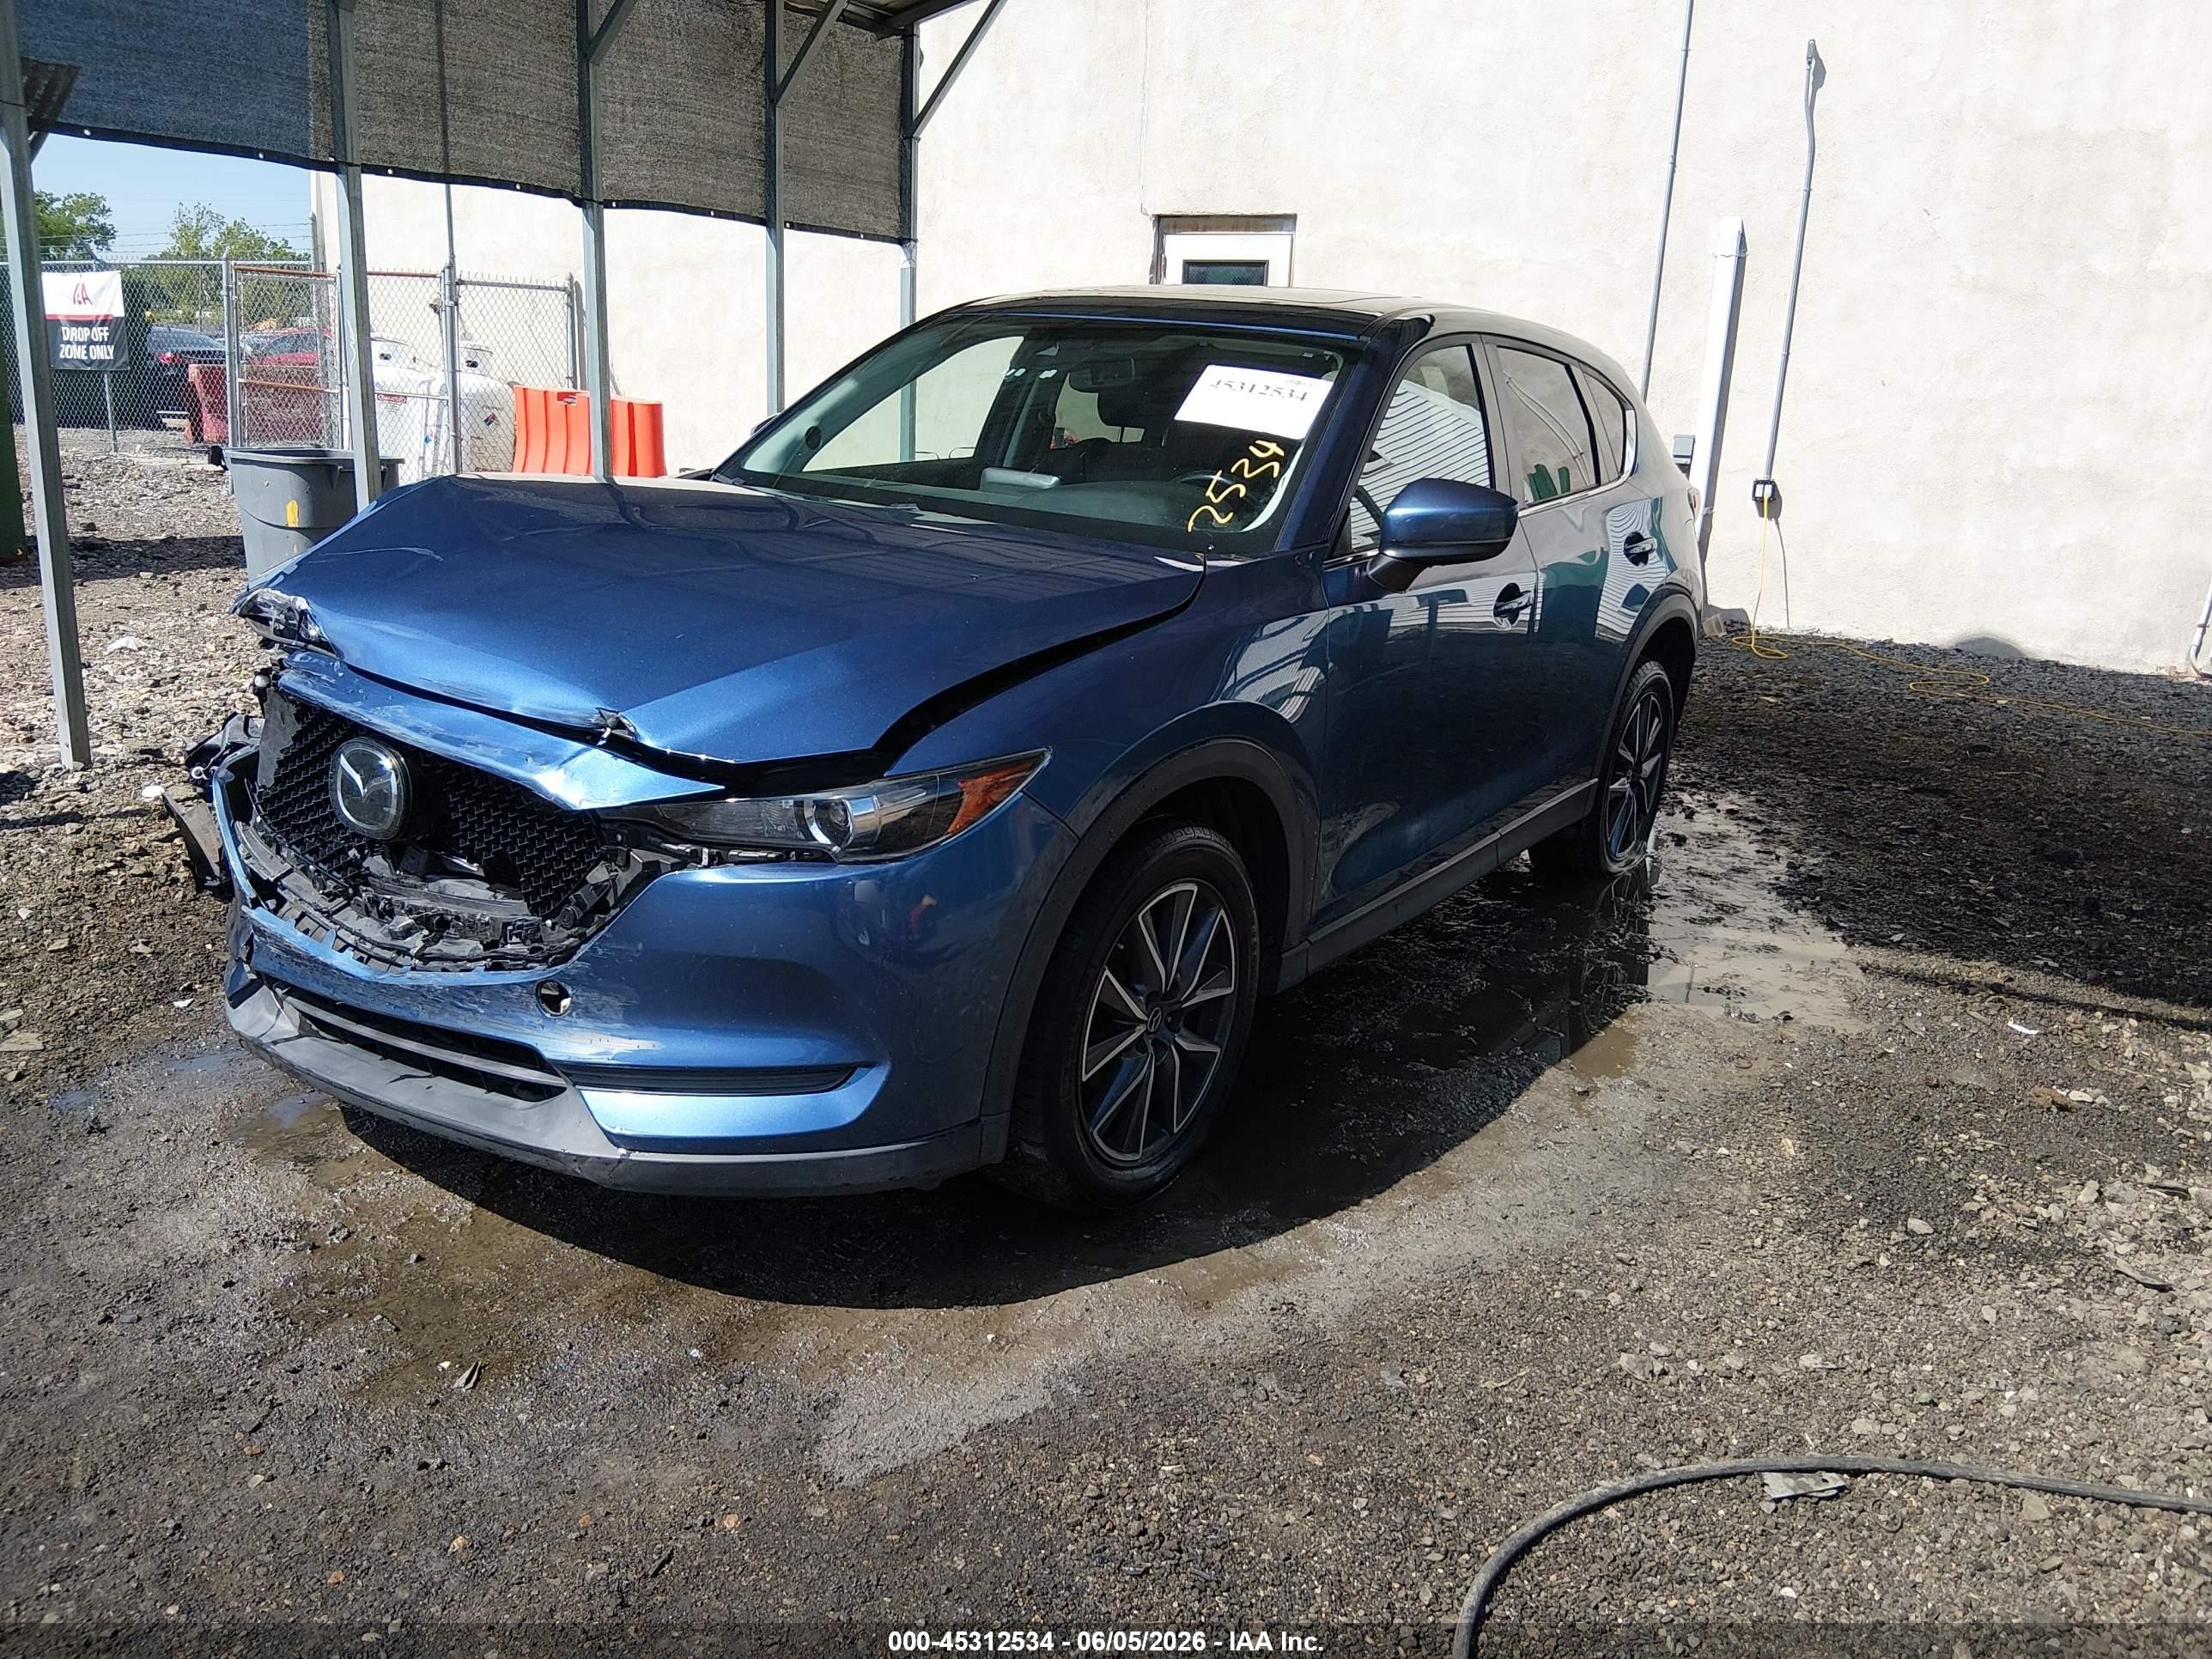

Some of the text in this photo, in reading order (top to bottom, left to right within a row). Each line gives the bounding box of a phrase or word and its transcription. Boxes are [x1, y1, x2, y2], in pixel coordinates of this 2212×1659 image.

[61, 326, 110, 342] DROP OFF
[59, 343, 115, 360] ZONE ONLY
[1188, 440, 1285, 532] 2534
